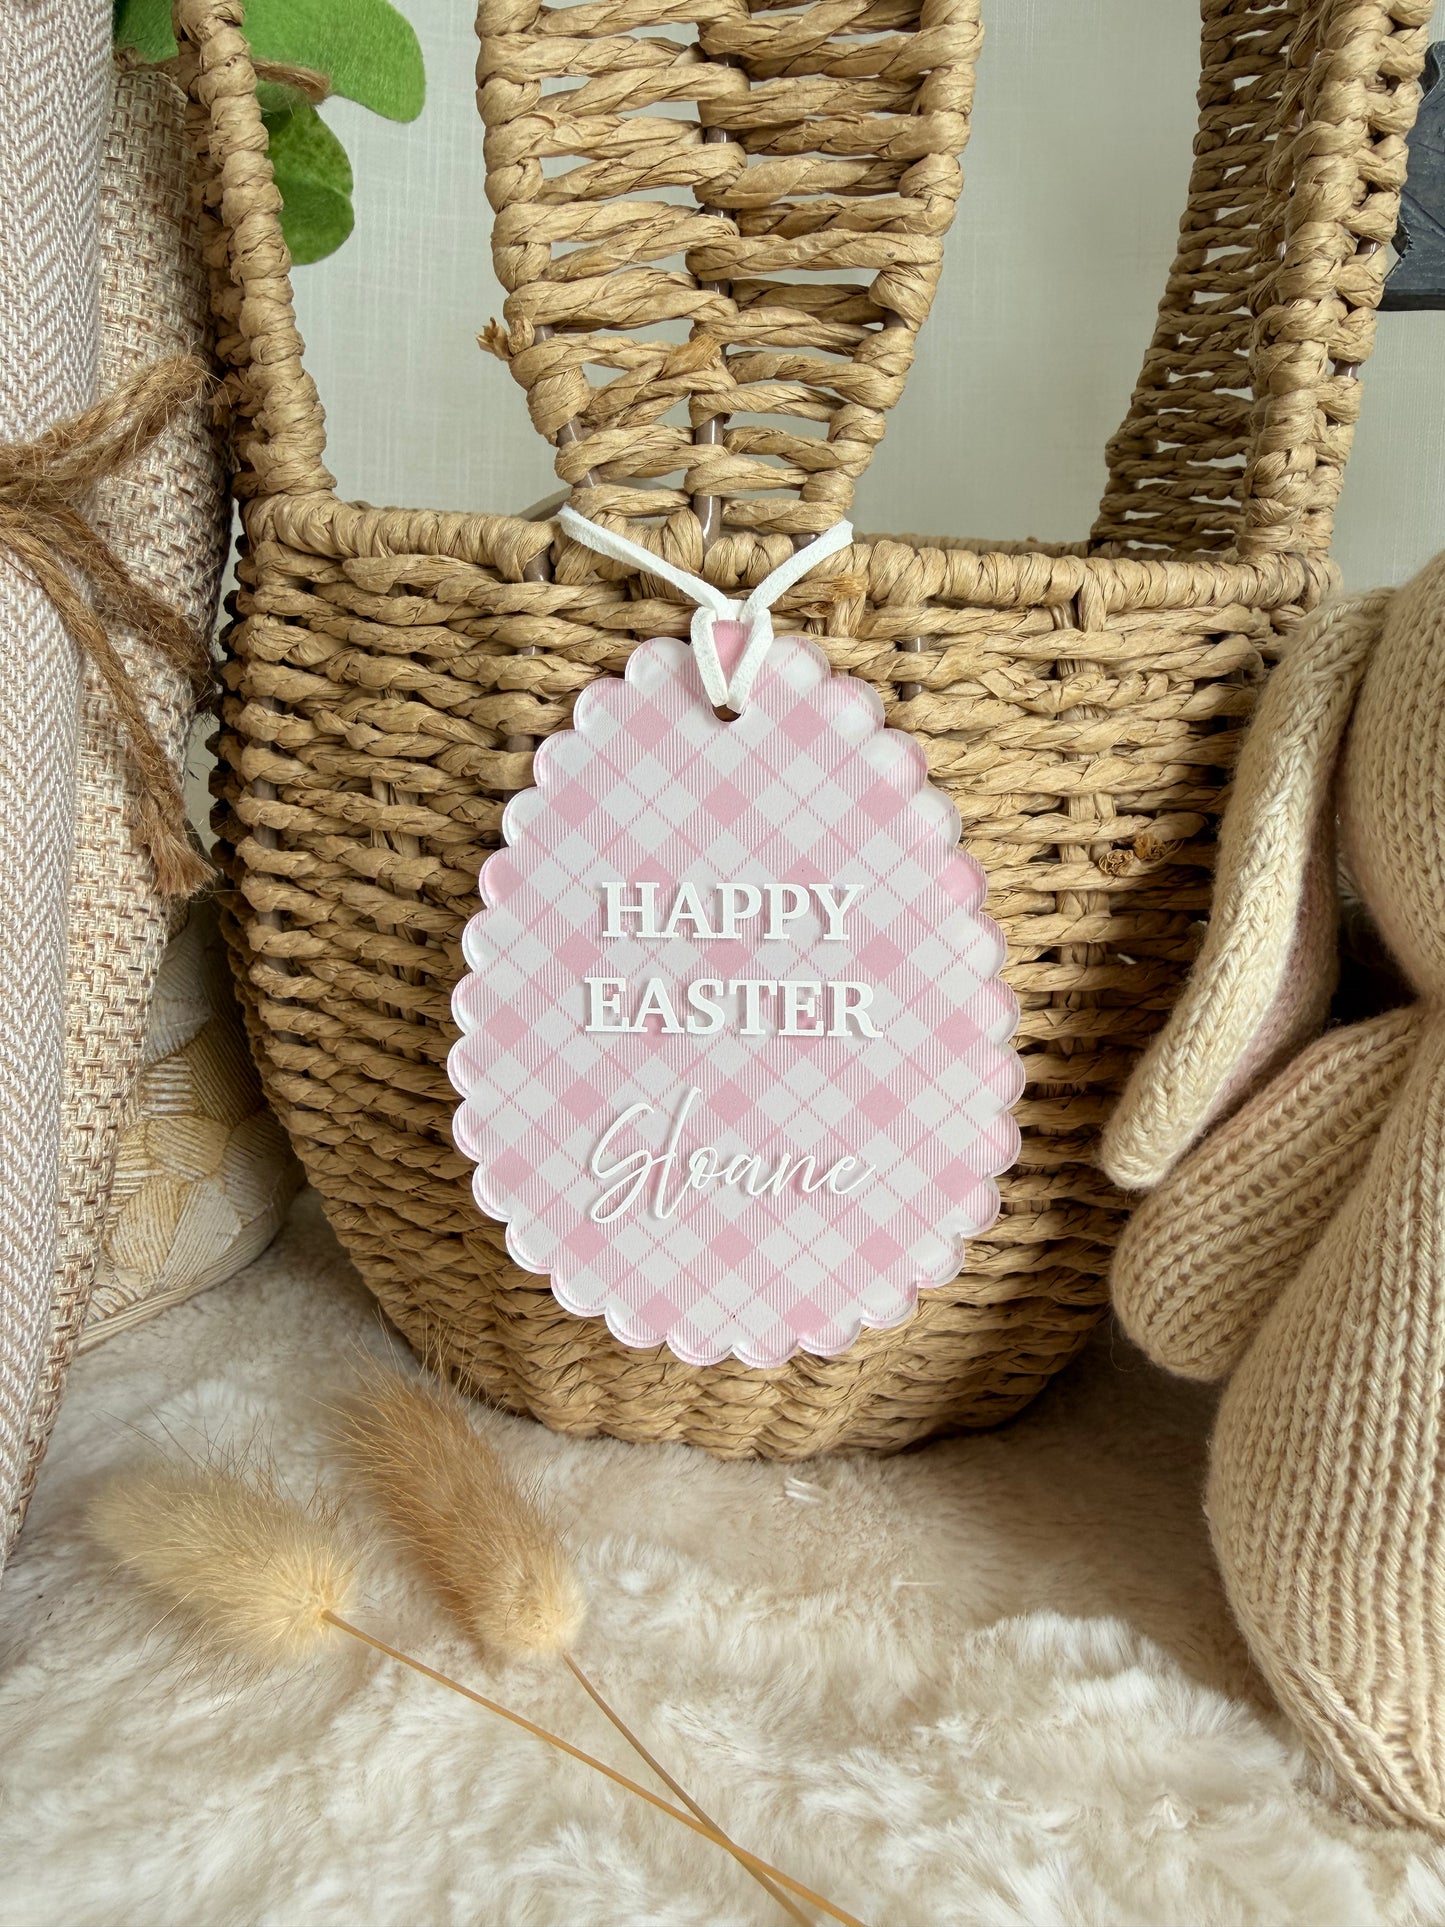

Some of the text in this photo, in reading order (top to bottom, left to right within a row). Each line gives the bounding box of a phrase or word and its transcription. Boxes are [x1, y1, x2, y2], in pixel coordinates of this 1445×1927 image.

[601, 881, 864, 941] HAPPY
[584, 977, 884, 1038] EASTER
[590, 1086, 876, 1224] Sloane
